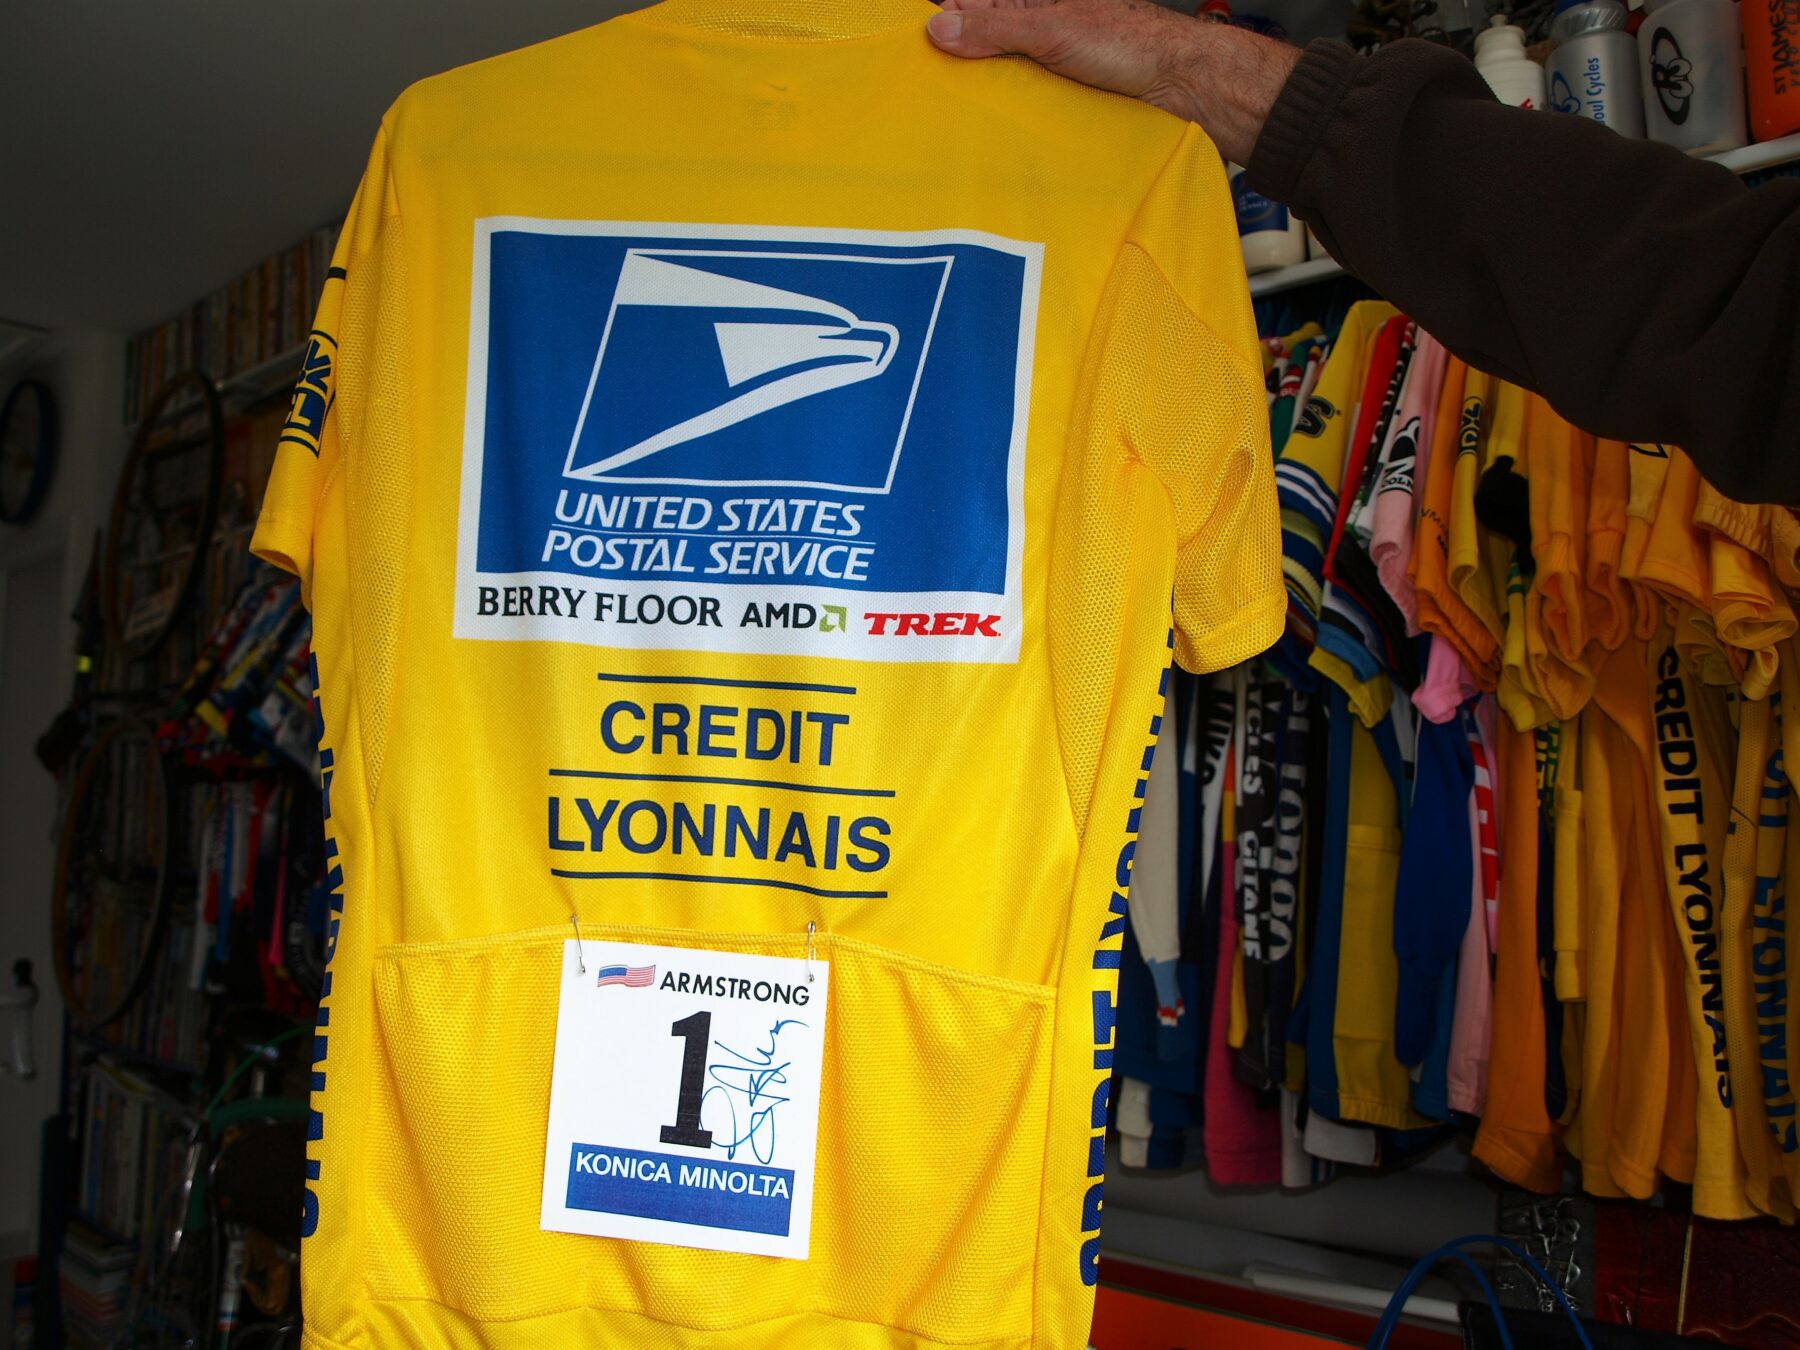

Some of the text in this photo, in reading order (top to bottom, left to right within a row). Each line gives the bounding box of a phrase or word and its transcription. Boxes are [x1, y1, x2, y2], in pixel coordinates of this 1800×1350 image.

[1584, 57, 1606, 97] Cycles
[555, 489, 865, 536] UNITED STATES
[541, 530, 875, 582] POSTAL SERVICE
[477, 585, 1001, 637] BERRY FLOOR AMD TREK
[600, 700, 850, 766] CREDIT
[1655, 645, 1704, 825] CREDIT
[548, 796, 892, 873] LYONNAIS
[660, 970, 810, 1006] ARMSTRONG
[659, 1010, 713, 1149] 1
[575, 1152, 790, 1200] KONICA MINOLTA
